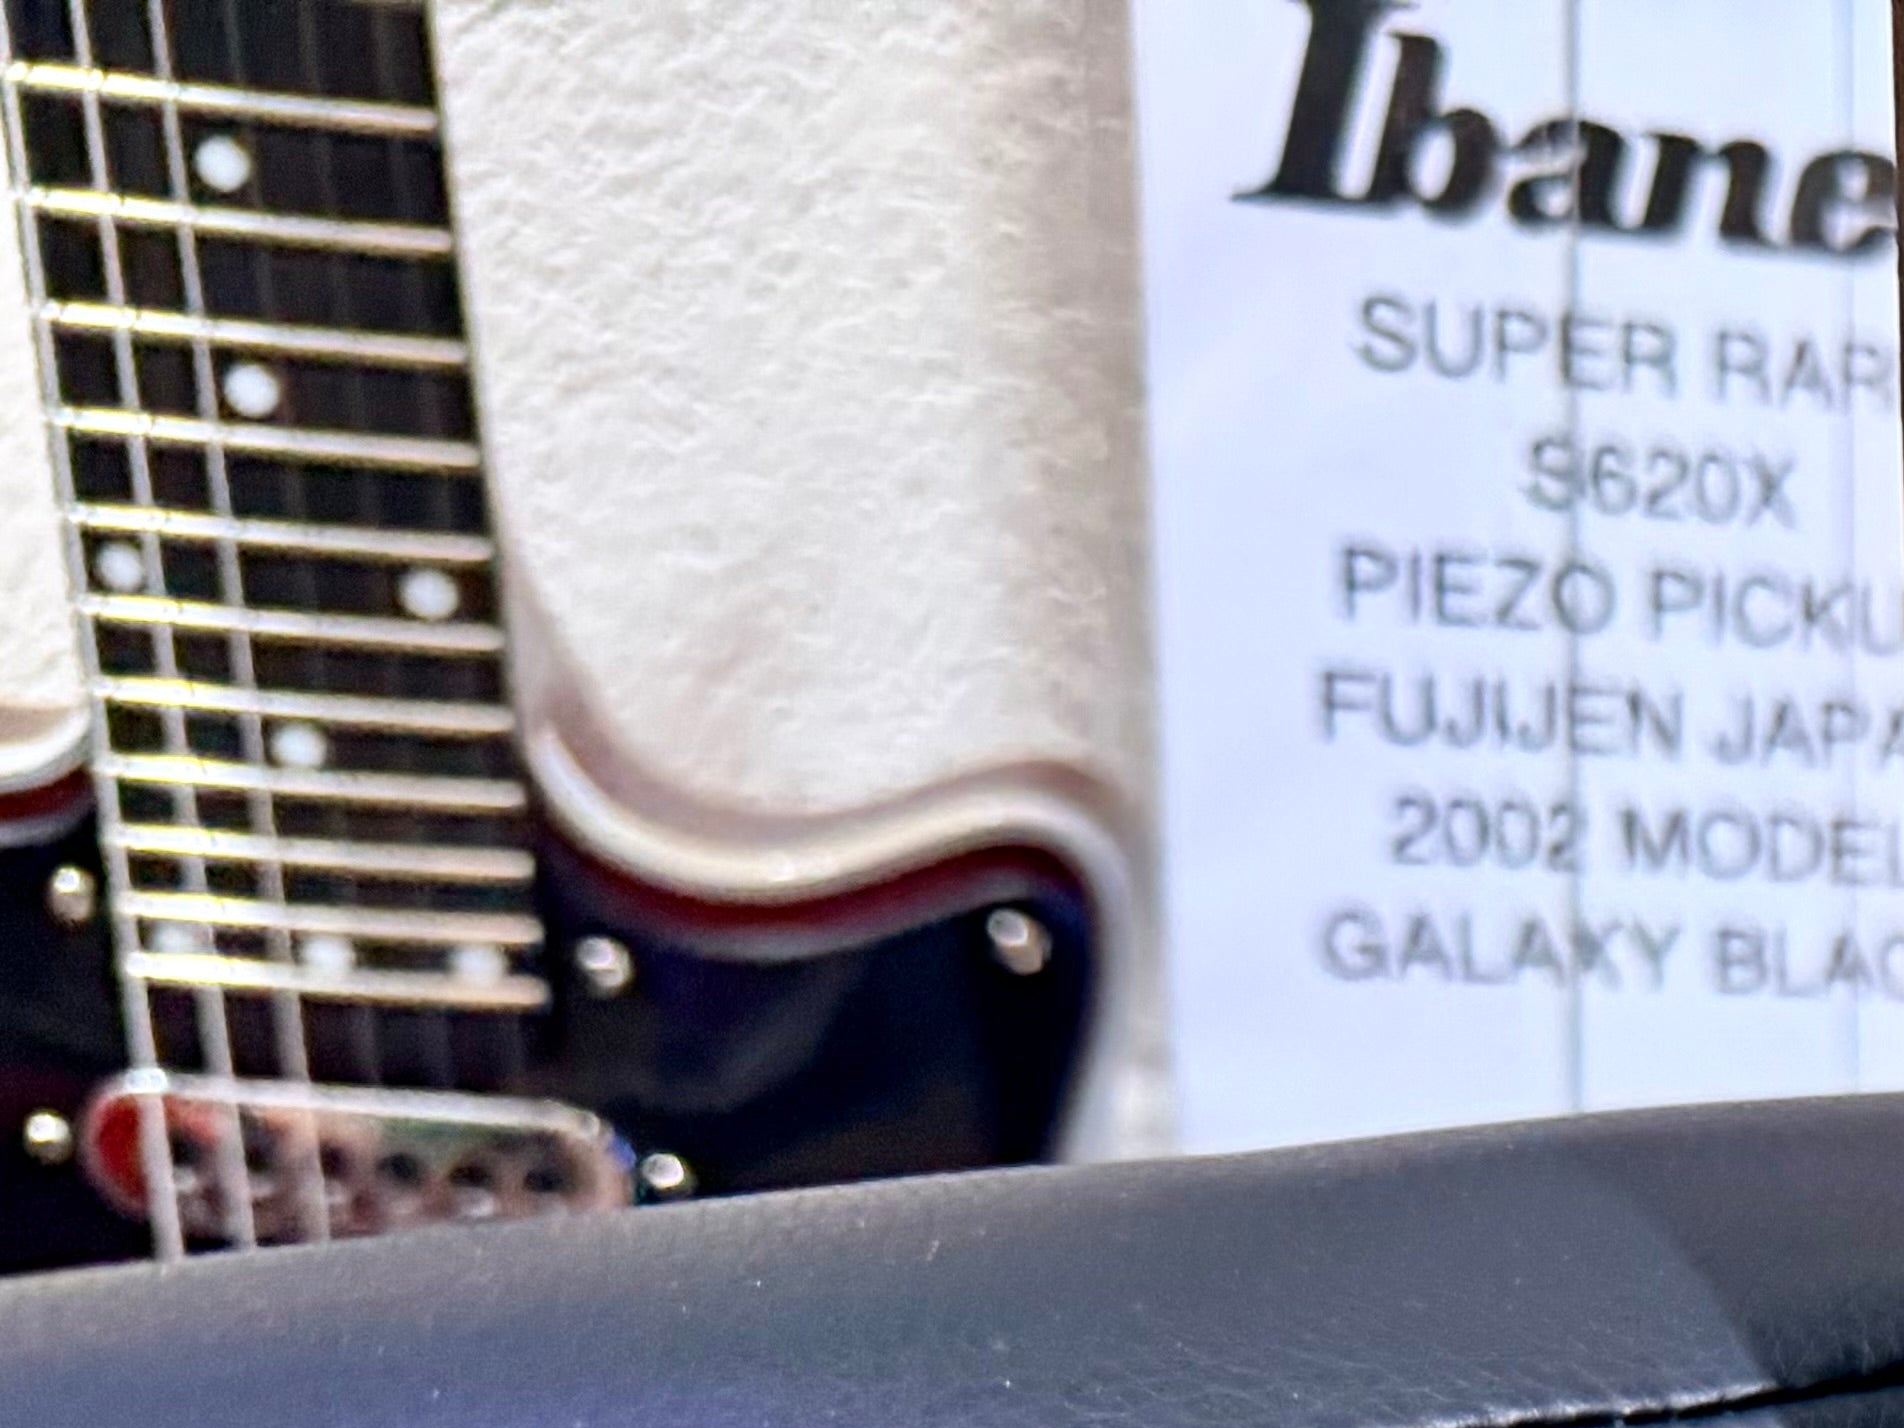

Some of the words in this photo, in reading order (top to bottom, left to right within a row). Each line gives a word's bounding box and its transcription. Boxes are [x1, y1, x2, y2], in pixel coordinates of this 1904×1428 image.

[1230, 0, 1895, 258] Ibane
[1354, 294, 1676, 398] SUPER
[1714, 326, 1896, 408] RAR
[1522, 432, 1796, 526] S620X
[1339, 542, 1617, 638] PIEZO
[1318, 668, 1684, 764] FUJIJEN
[1389, 796, 1584, 869] 2002
[1320, 906, 1677, 990] GALAXY
